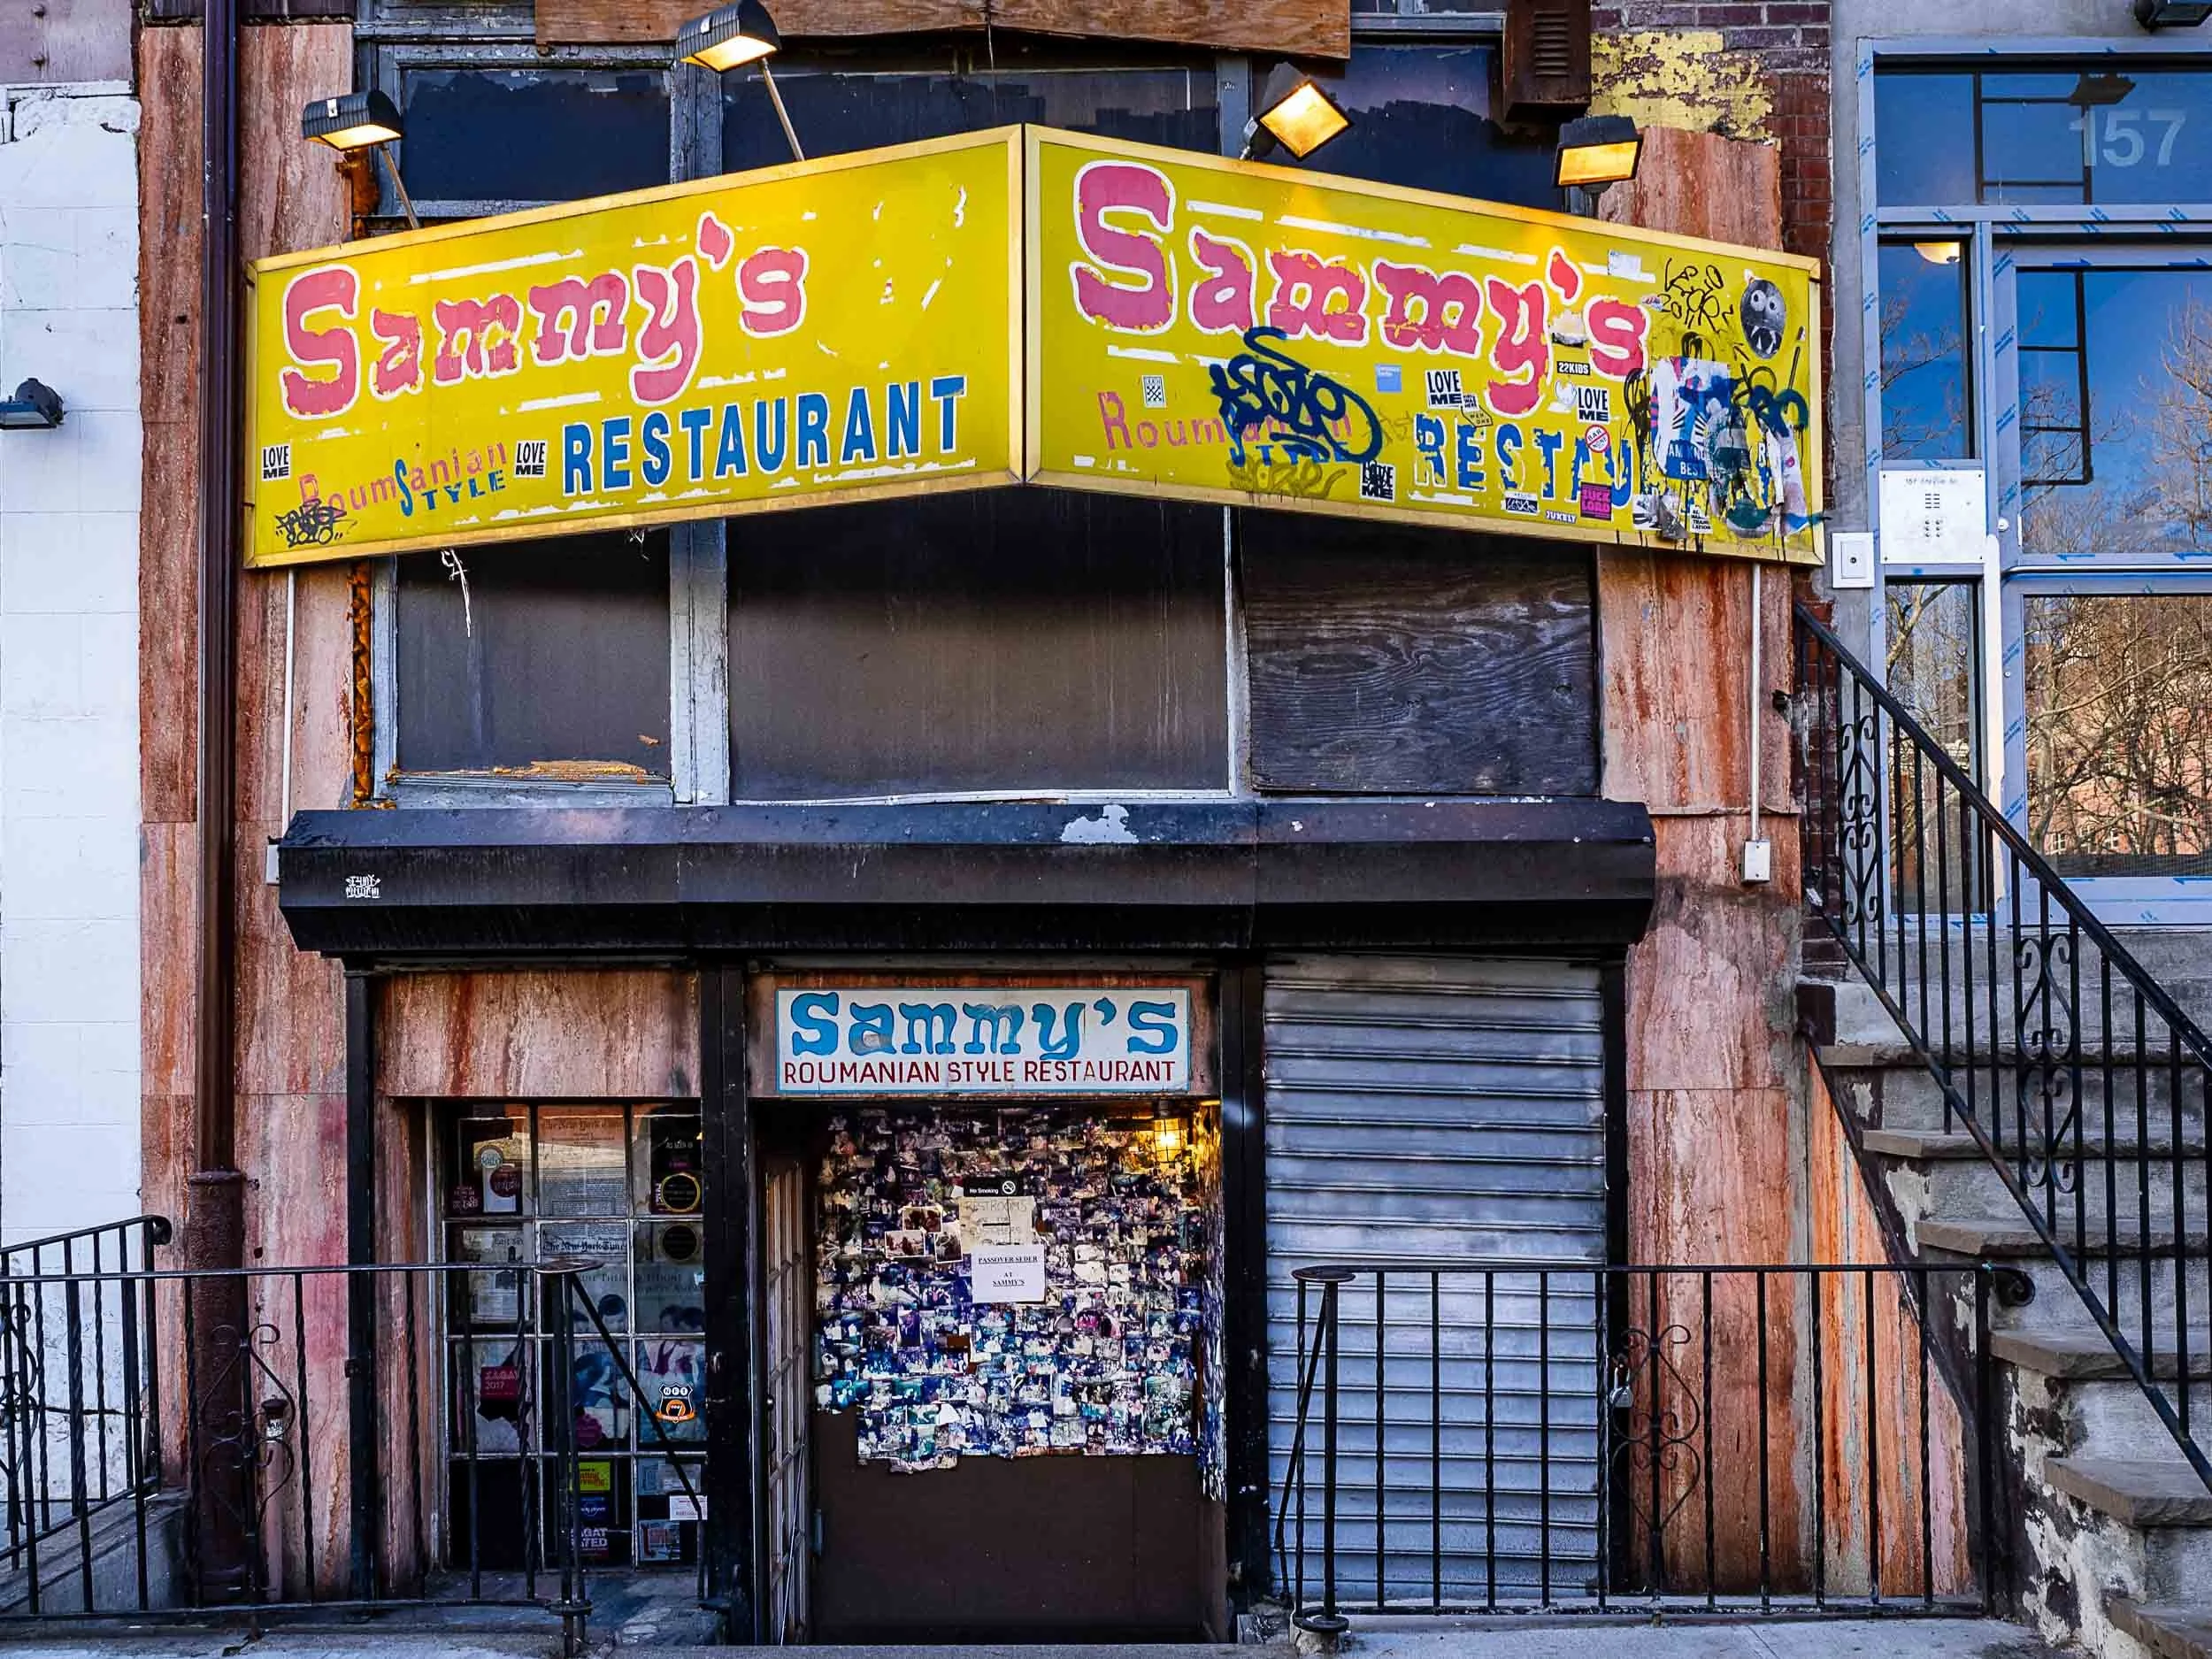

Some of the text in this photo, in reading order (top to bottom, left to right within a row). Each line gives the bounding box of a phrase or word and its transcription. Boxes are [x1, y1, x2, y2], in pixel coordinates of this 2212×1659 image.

[2070, 110, 2187, 167] 157
[1069, 159, 1650, 419] Sammy's
[281, 211, 809, 419] Sammy's
[1558, 363, 1590, 374] 22KIDS
[1427, 371, 1460, 393] LOVE
[1430, 394, 1462, 405] ME
[1578, 388, 1609, 411] LOVE
[1578, 411, 1609, 422] ME
[563, 375, 967, 496] RESTAURANT
[1588, 428, 1602, 441] BAR
[263, 445, 289, 468] LOVE
[515, 442, 546, 465] LOVE
[263, 467, 289, 479] ME
[515, 465, 544, 476] ME
[395, 458, 507, 518] STYLE
[784, 1060, 1176, 1084] ROUMANIAN STYLE RESTAURANT
